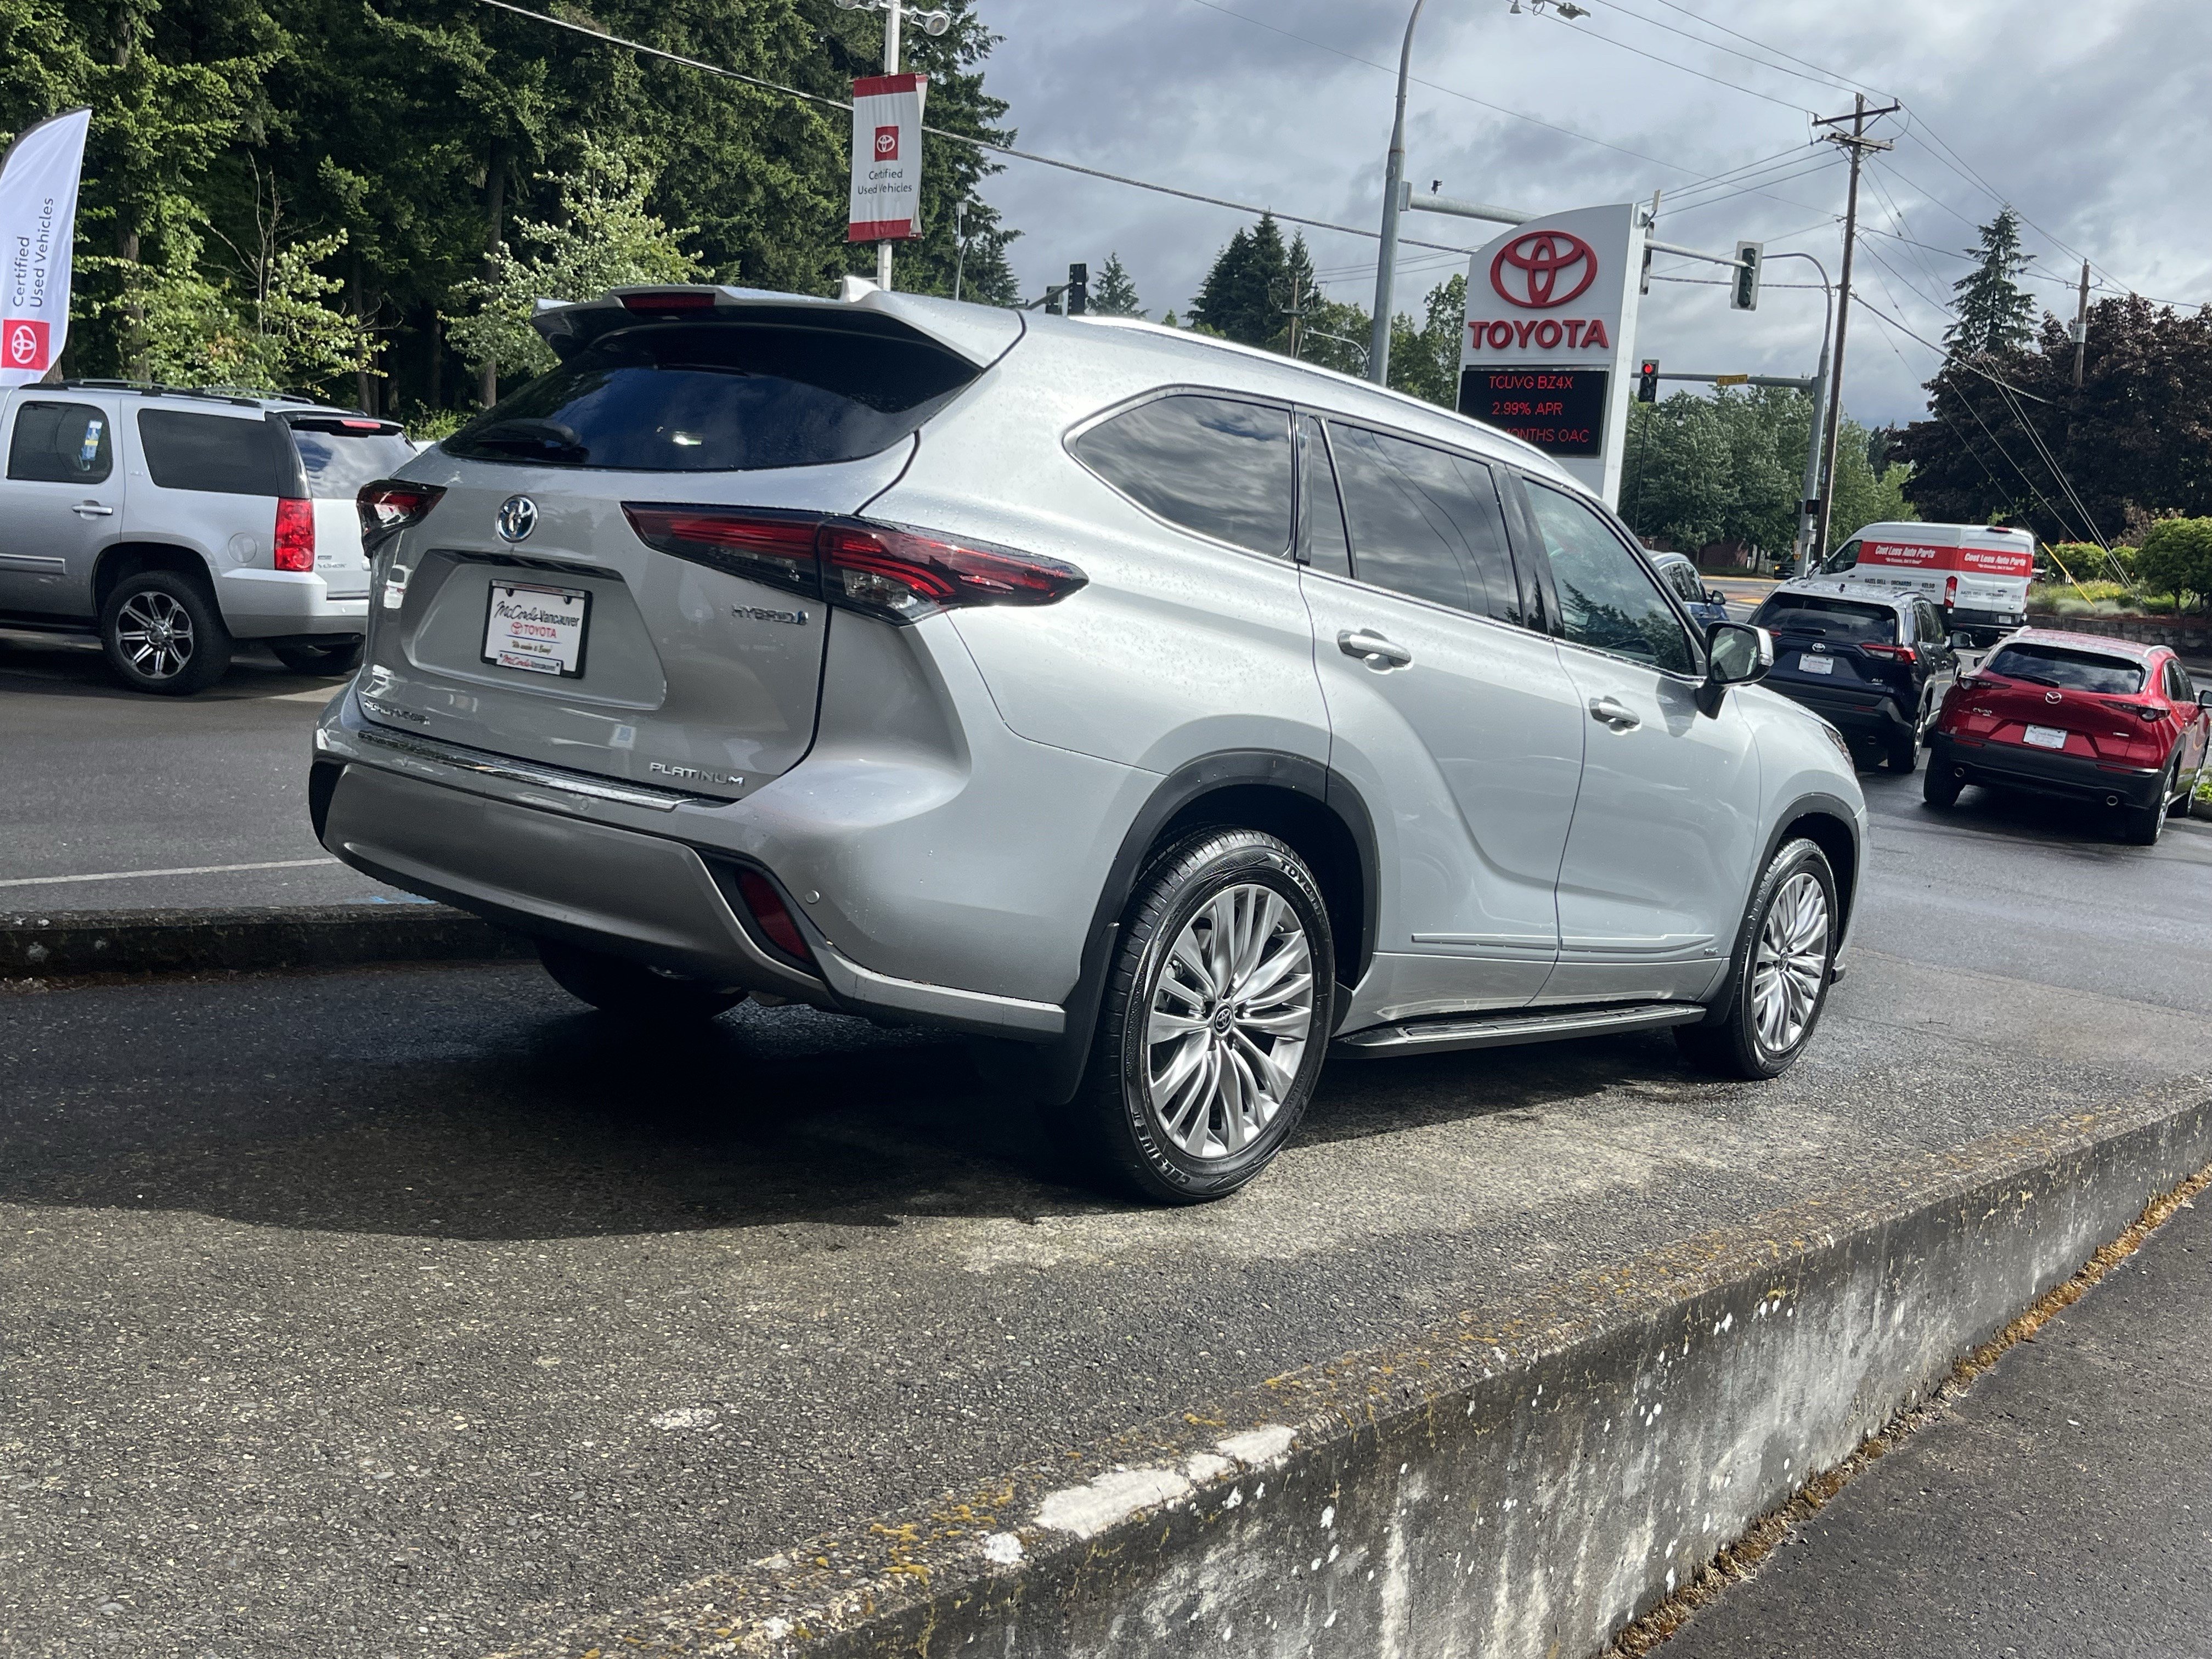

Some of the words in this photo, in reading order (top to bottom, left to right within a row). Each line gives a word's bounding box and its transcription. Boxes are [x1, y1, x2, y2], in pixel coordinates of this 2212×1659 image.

[869, 168, 903, 180] Certified
[857, 184, 878, 195] Used
[878, 183, 912, 193] Vehicles
[35, 198, 54, 264] Vehicles
[13, 236, 30, 307] Certified
[30, 268, 45, 308] Used
[1468, 319, 1609, 349] TOYOTA
[1489, 375, 1534, 389] TCUVG
[1537, 375, 1574, 390] BZ4X
[1492, 401, 1532, 416] 2.99%
[1534, 402, 1564, 416] APR
[1558, 428, 1590, 443] OAC
[1875, 545, 1889, 555] Cost
[1888, 546, 1903, 556] Less
[1901, 546, 1917, 557] Auto
[1916, 548, 1936, 558] Parts
[1965, 552, 1980, 562] Cost
[2010, 557, 2026, 567] Parts
[731, 604, 796, 624] HYBRID
[524, 624, 557, 639] TOYOTA
[650, 761, 745, 787] PLATINUM
